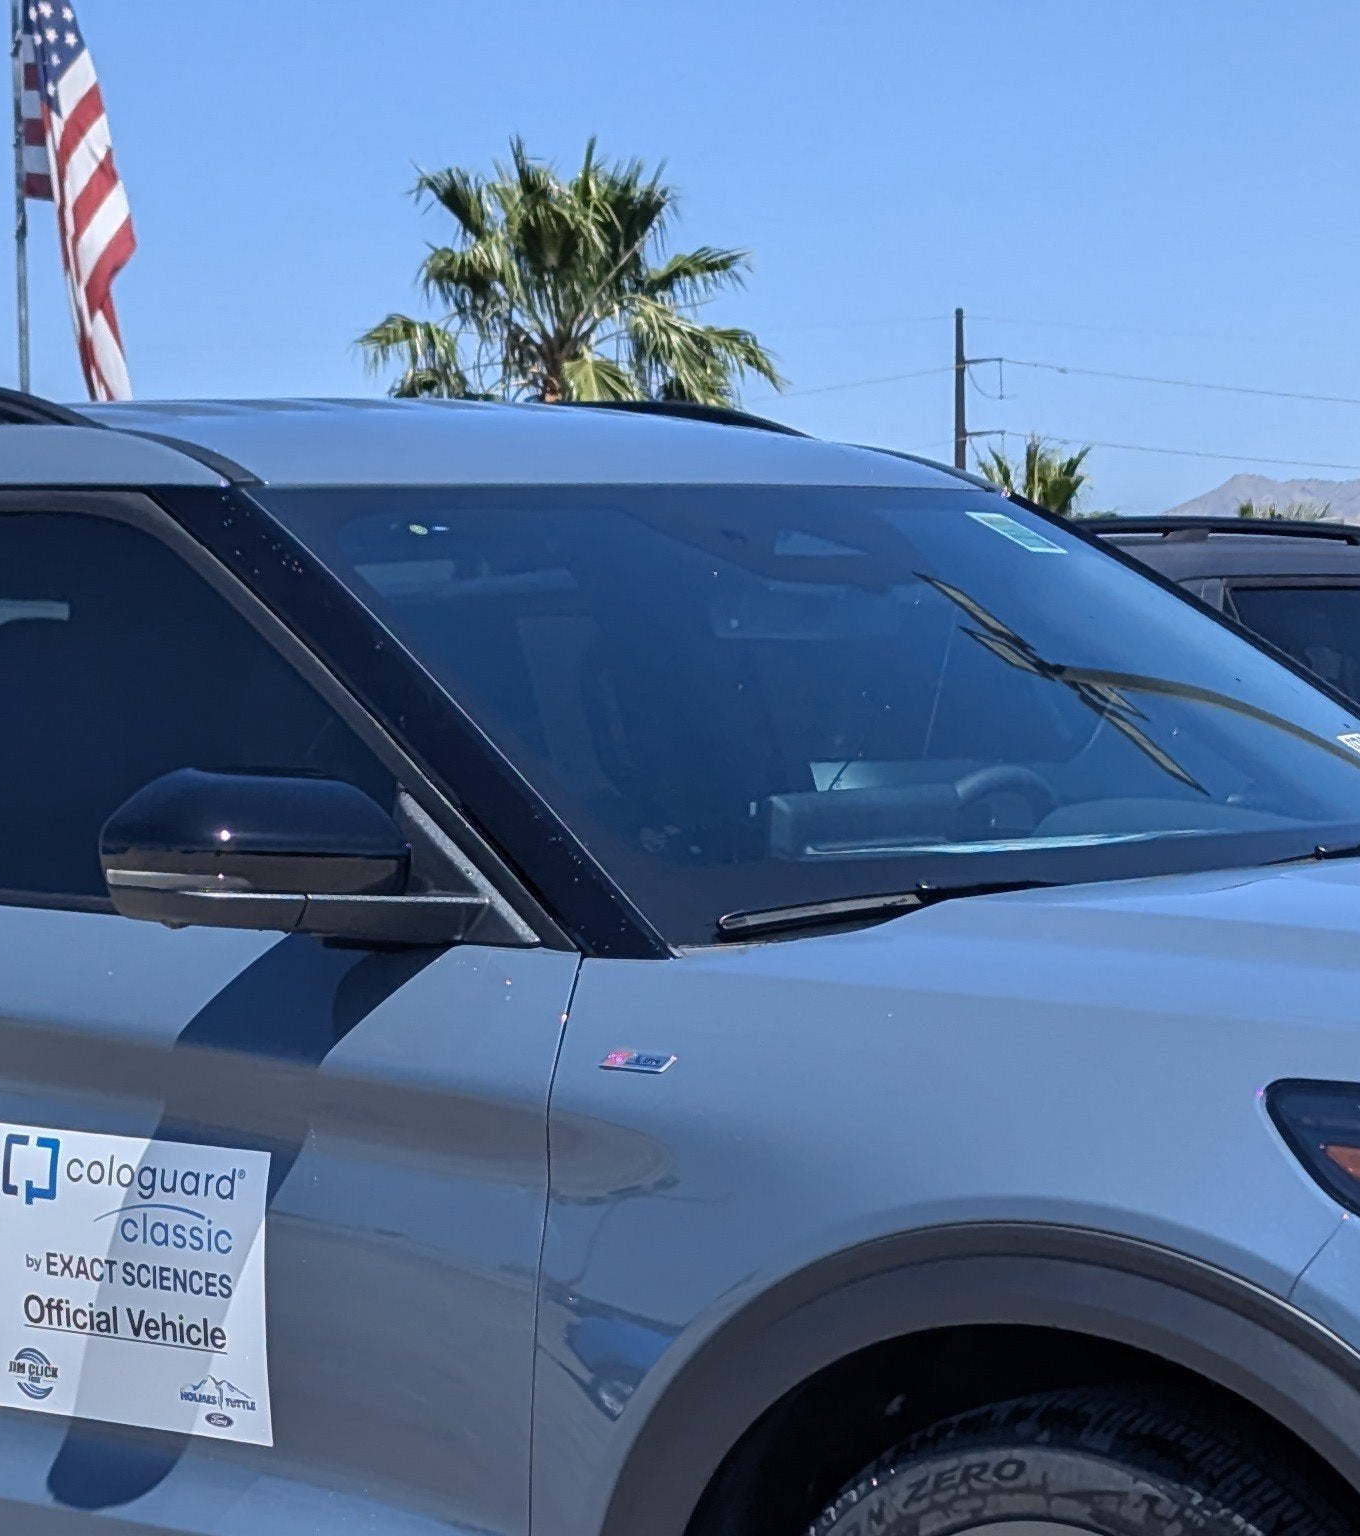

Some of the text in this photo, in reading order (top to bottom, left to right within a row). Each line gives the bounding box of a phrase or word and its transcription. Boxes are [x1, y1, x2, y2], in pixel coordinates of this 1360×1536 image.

[120, 1212, 232, 1255] classic
[25, 1252, 232, 1299] by EXACT SCIENCES
[24, 1294, 227, 1350] Official Vehicle
[8, 1360, 59, 1379] JIM CLICK
[903, 1457, 1027, 1509] ZERO
